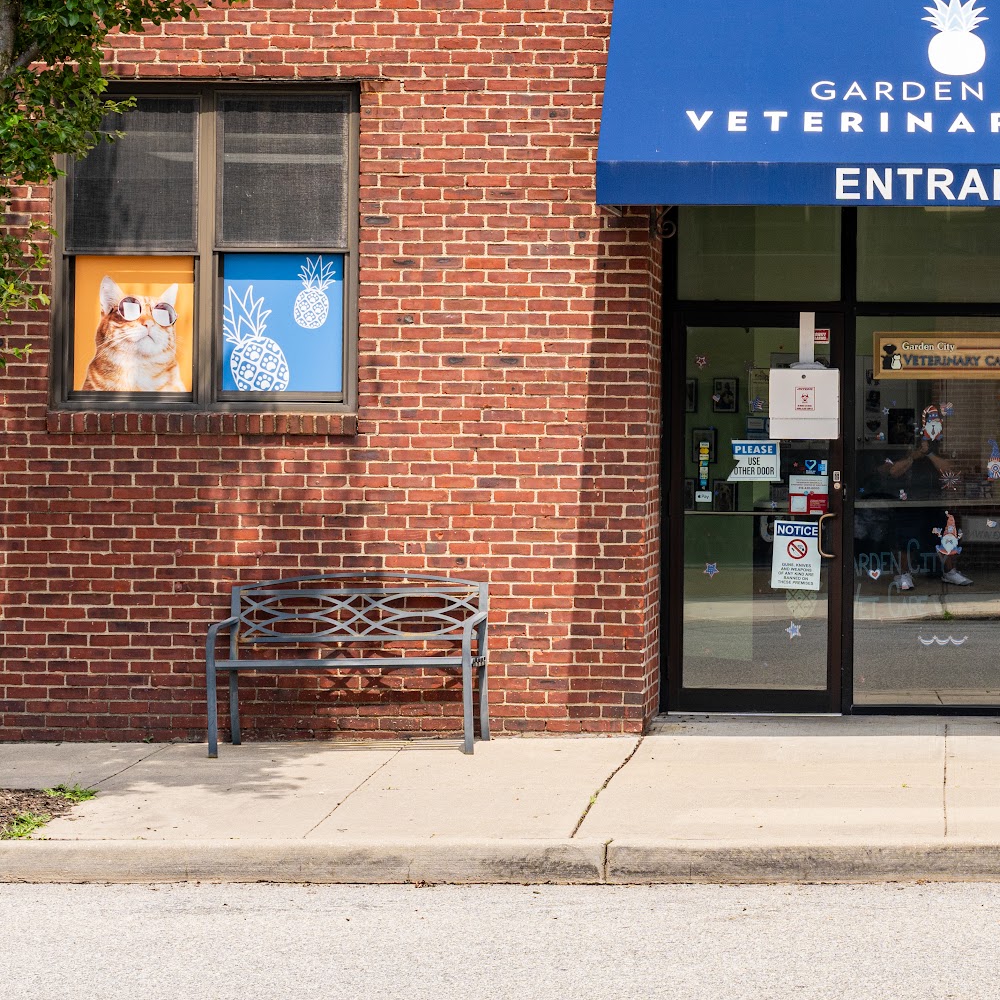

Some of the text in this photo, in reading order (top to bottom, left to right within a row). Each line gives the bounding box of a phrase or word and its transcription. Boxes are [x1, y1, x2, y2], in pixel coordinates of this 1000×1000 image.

[810, 80, 985, 102] GARDEN
[902, 341, 956, 353] Garden City
[902, 354, 981, 367] VETERINARY
[734, 445, 773, 454] PLEASE
[747, 456, 761, 466] USE
[734, 466, 775, 476] OTHER DOOR
[777, 525, 818, 536] NOTICE
